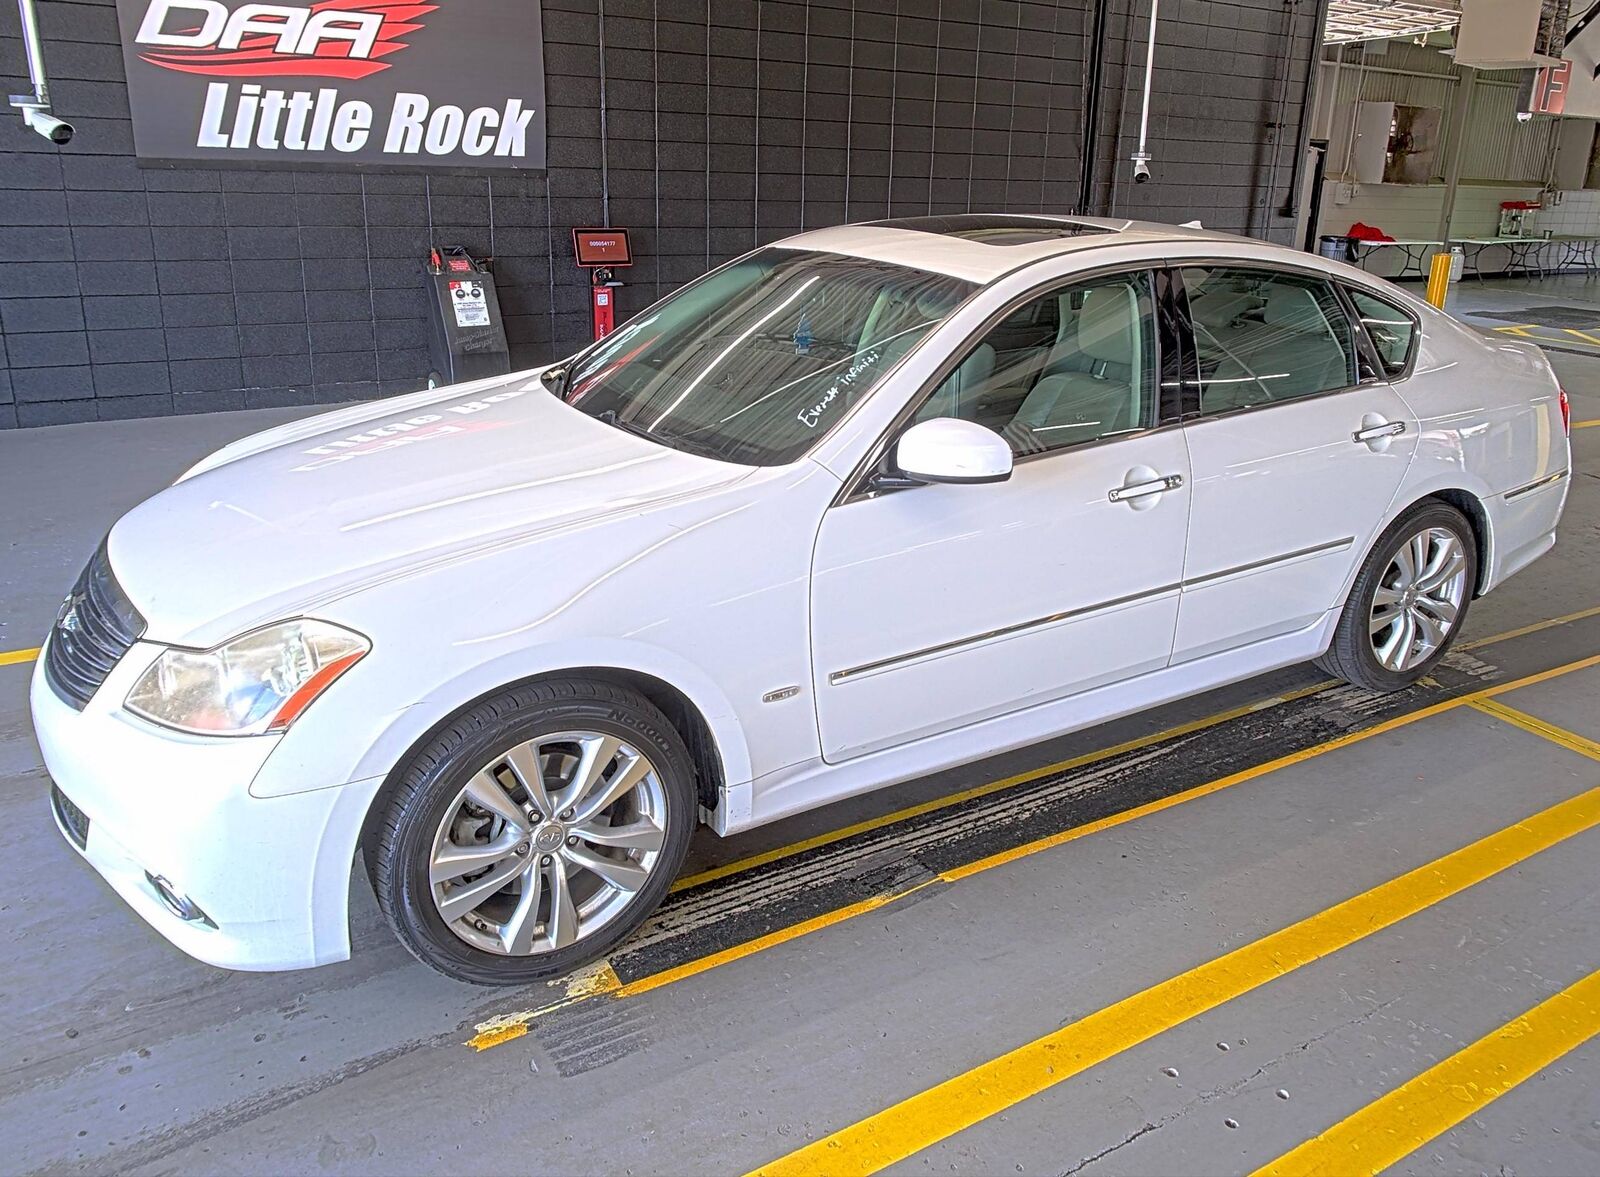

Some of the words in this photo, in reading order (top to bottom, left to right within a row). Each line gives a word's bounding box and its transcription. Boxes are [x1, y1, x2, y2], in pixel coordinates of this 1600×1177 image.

[134, 0, 384, 59] DAA
[196, 81, 374, 153] Little
[383, 91, 536, 157] Rock
